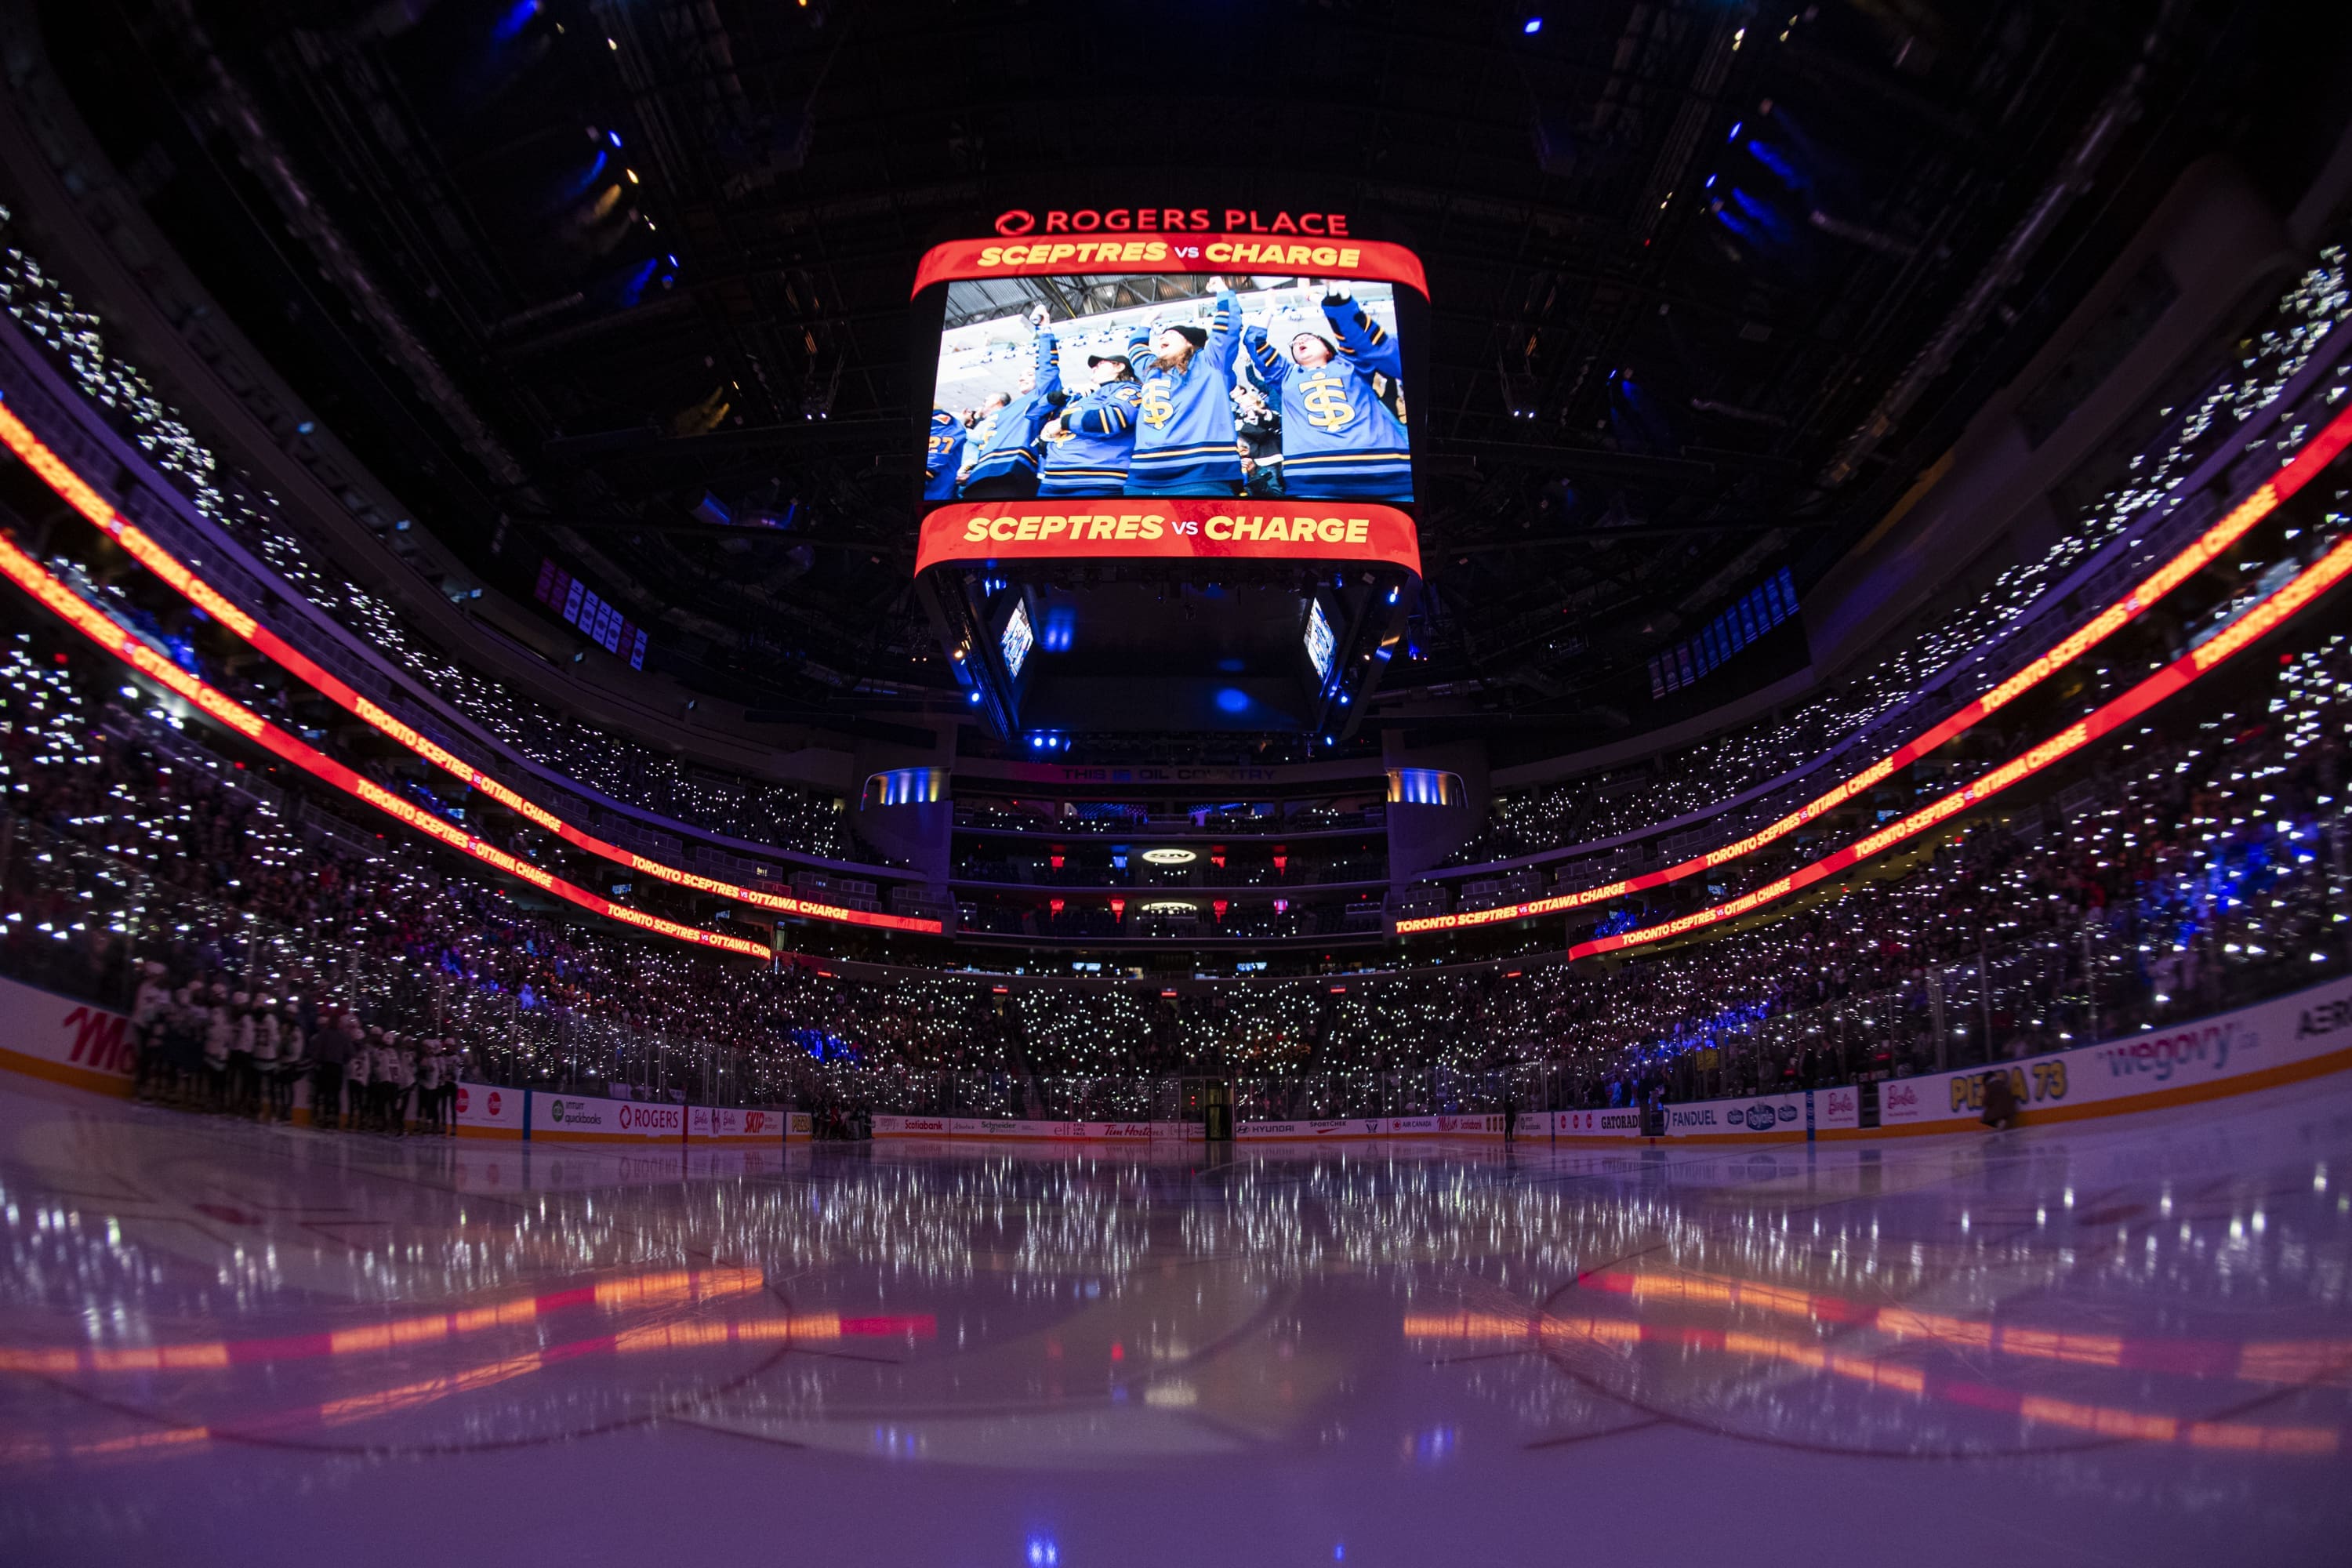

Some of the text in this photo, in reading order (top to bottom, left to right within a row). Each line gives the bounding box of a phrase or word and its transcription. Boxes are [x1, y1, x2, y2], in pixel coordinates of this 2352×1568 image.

[1046, 209, 1349, 236] ROGERS PLACE
[977, 241, 1168, 267] SCEPTRES
[1205, 243, 1361, 268] CHARGE
[964, 515, 1165, 542] SCEPTRES
[1204, 515, 1370, 543] CHARGE
[354, 697, 417, 746] TORONTO
[415, 735, 474, 781] SCEPTRES
[480, 777, 524, 811] OTTAWA
[521, 800, 562, 832] CHARGE
[1062, 768, 1107, 780] THIS
[1139, 768, 1169, 780] OIL
[1854, 822, 1907, 858] TORONTO
[1905, 791, 1965, 833] SCEPTRES
[1973, 757, 2029, 798] OTTAWA
[2027, 723, 2087, 767] CHARGE
[1705, 835, 1756, 866] TORONTO
[1755, 813, 1801, 848] SCEPTRES
[1806, 785, 1849, 817] OTTAWA
[1847, 757, 1894, 796] CHARGE
[357, 779, 415, 820] TORONTO
[414, 811, 470, 848] SCEPTRES
[475, 843, 517, 873] OTTAWA
[514, 862, 554, 887] CHARGE
[630, 854, 681, 883] TORONTO
[682, 873, 739, 898] SCEPTRES
[749, 891, 797, 911] OTTAWA
[799, 902, 848, 920] CHARGE
[1396, 916, 1456, 934] TORONTO
[1457, 906, 1518, 926] SCEPTRES
[1528, 895, 1579, 914] OTTAWA
[1580, 882, 1626, 902] CHARGE
[1622, 924, 1670, 946] TORONTO
[1670, 909, 1717, 933] SCEPTRES
[1724, 893, 1759, 916] OTTAWA
[1757, 877, 1791, 902] CHARGE
[608, 903, 653, 928] TORONTO
[653, 919, 700, 942] SCEPTRES
[709, 932, 750, 953] OTTAWA
[2032, 1059, 2068, 1102] 73
[564, 1113, 602, 1126] quickbooks
[634, 1109, 679, 1128] ROGERS
[744, 1111, 765, 1134] SKIP
[905, 1120, 943, 1131] Scotiabank
[981, 1121, 1017, 1133] Schneider
[1104, 1124, 1123, 1136] Tim
[1125, 1124, 1164, 1136] Hortons
[1672, 1110, 1718, 1127] FANDUEL
